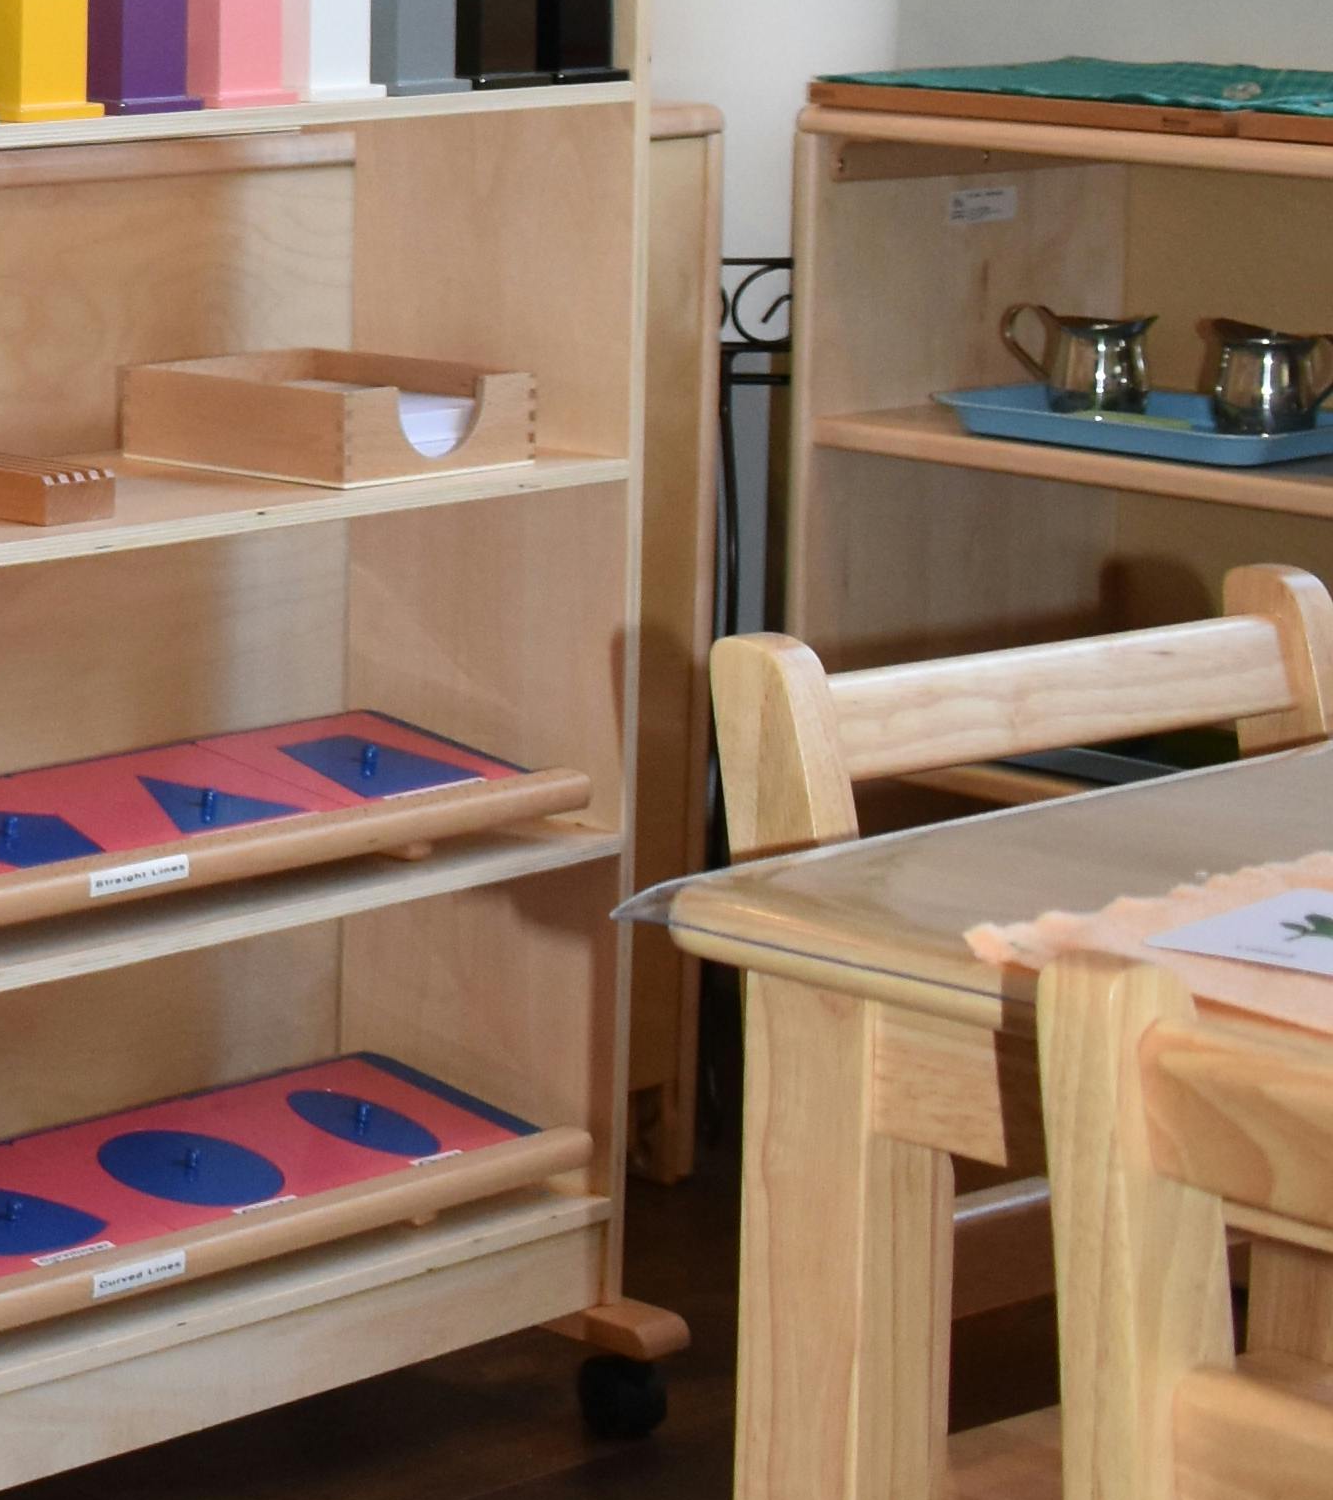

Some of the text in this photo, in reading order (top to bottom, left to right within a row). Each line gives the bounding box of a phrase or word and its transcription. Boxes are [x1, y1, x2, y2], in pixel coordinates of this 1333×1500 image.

[95, 864, 186, 888] Straight Lines
[99, 1261, 182, 1289] Curved Lines
